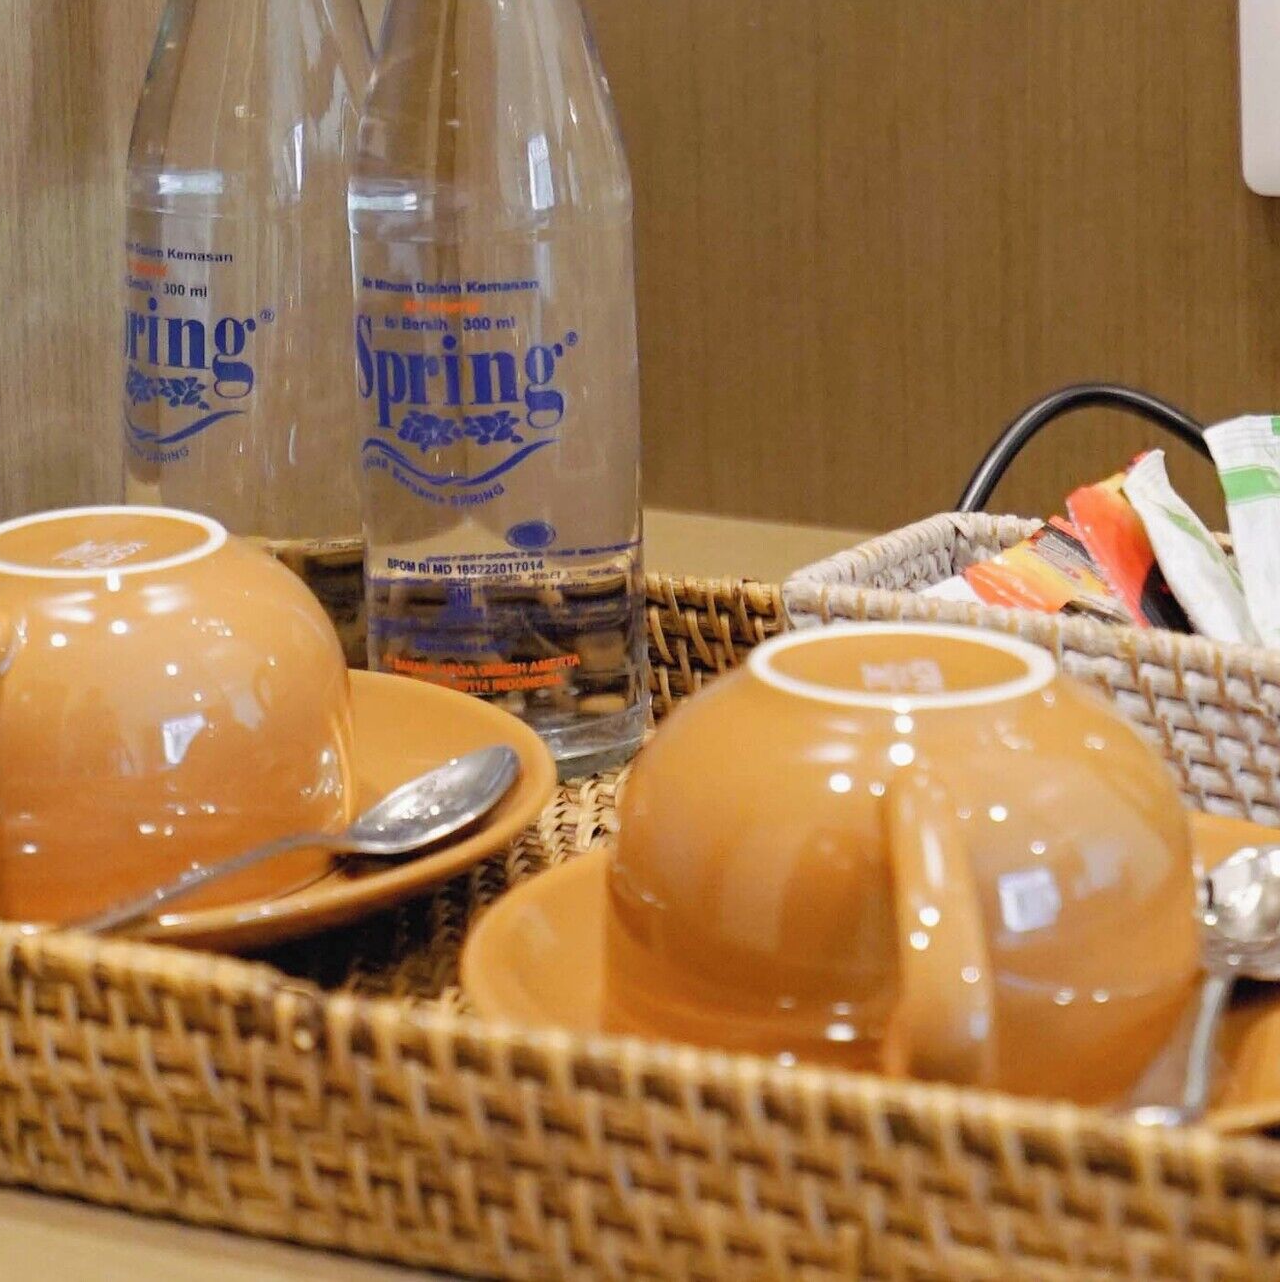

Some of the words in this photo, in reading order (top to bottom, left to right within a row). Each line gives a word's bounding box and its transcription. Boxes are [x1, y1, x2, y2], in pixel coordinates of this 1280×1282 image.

[167, 248, 234, 263] Kemasan
[163, 283, 186, 297] 300
[190, 285, 208, 299] ml
[467, 278, 539, 294] Kemasan
[463, 317, 491, 331] 300
[496, 316, 516, 330] ml
[125, 297, 257, 399] ring
[356, 314, 565, 430] Spring
[433, 564, 453, 575] MD
